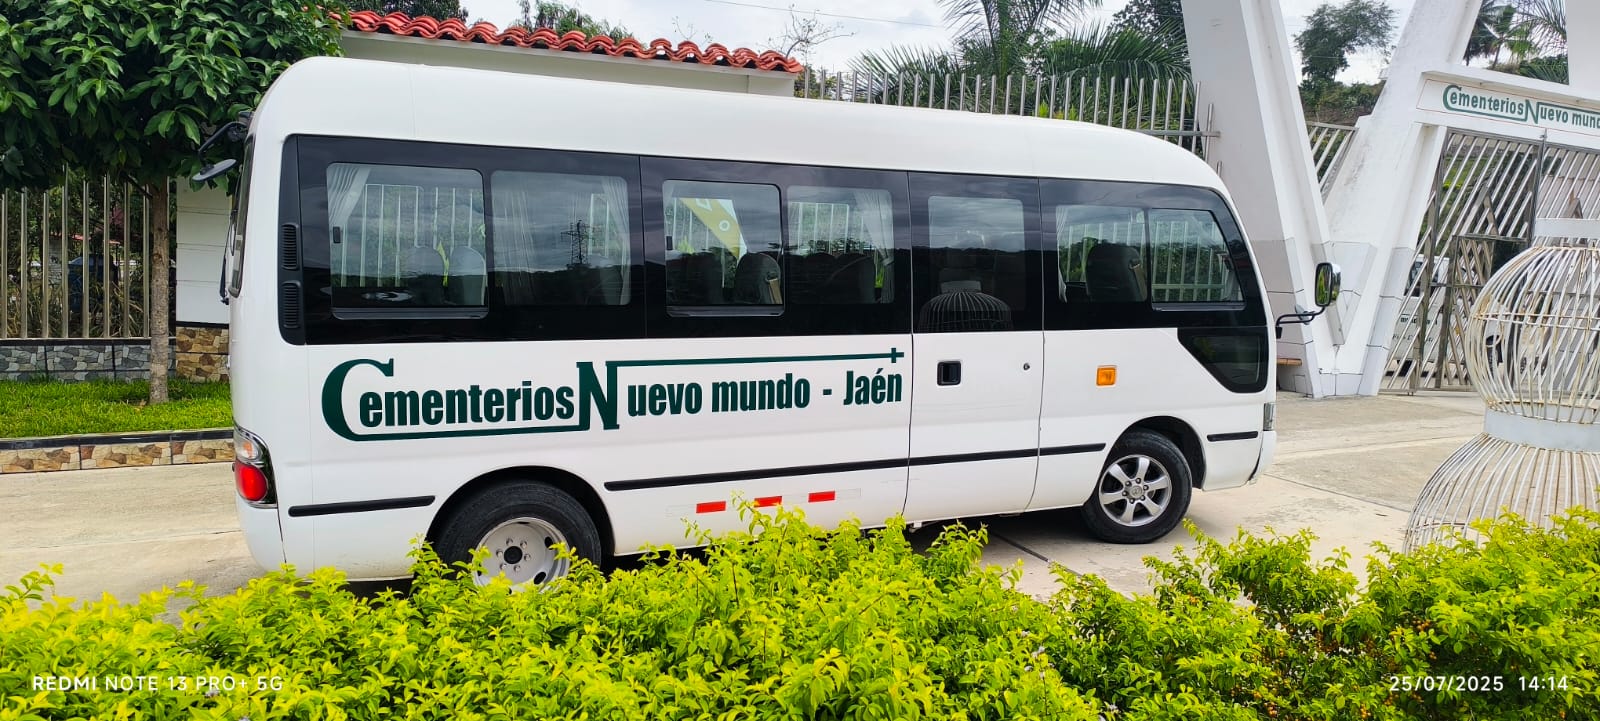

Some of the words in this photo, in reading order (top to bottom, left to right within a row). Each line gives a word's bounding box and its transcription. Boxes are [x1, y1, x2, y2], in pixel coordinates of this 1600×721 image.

[1443, 84, 1524, 120] Cementerios
[1525, 98, 1568, 125] Nuevo
[321, 358, 575, 441] Cementerios
[576, 361, 703, 430] Nuevo
[711, 373, 811, 413] mundo
[843, 368, 903, 406] Jaén
